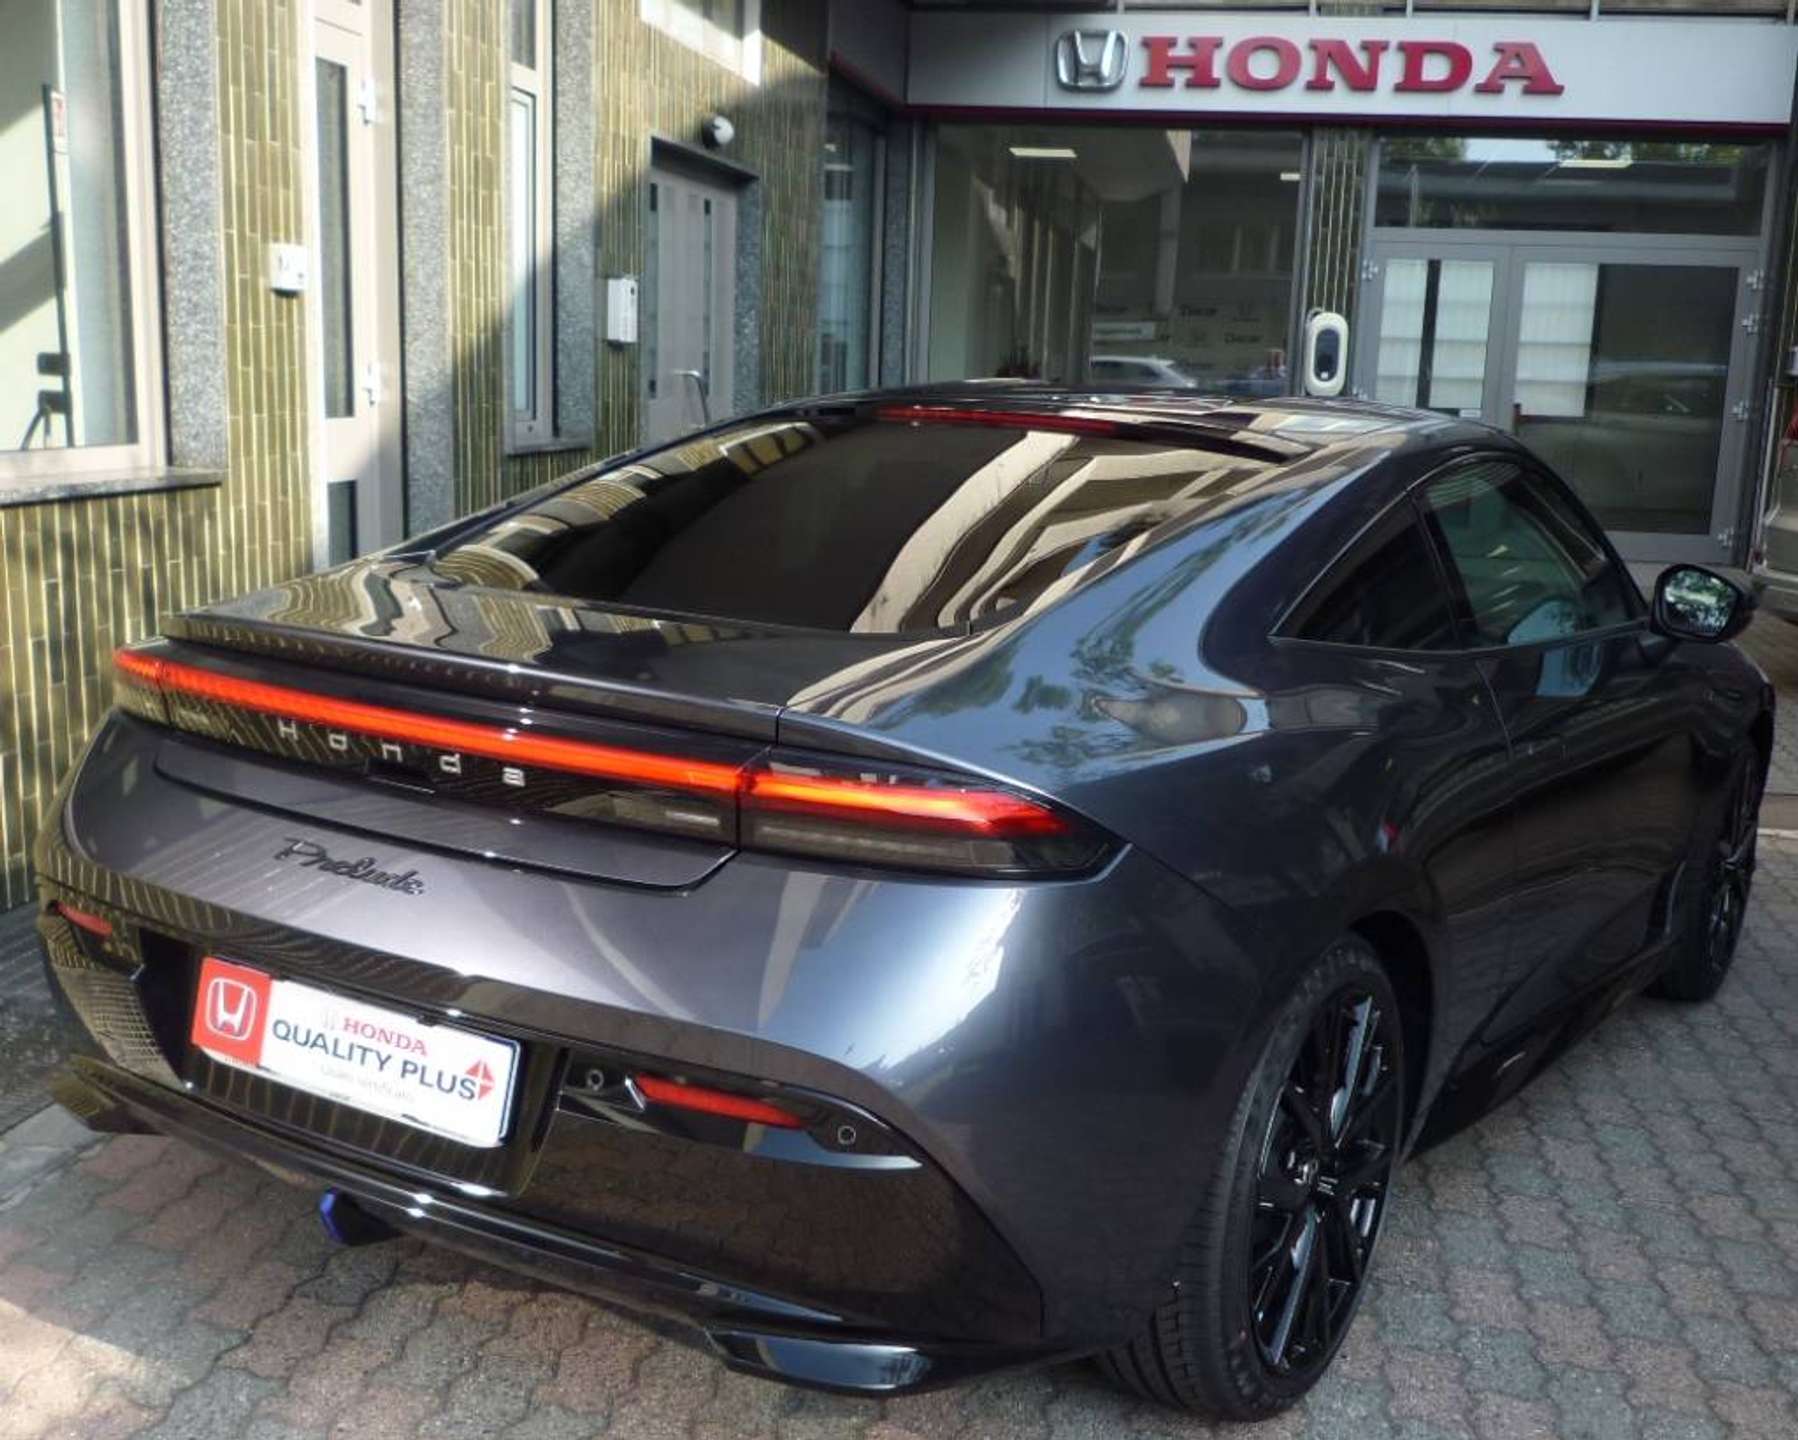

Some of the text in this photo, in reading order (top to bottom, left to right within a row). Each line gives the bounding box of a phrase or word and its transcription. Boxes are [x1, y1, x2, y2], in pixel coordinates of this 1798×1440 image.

[1138, 36, 1565, 97] HONDA
[271, 1017, 392, 1073] QUALITY
[400, 1059, 477, 1101] PLUS
[342, 1015, 428, 1056] HONDA
